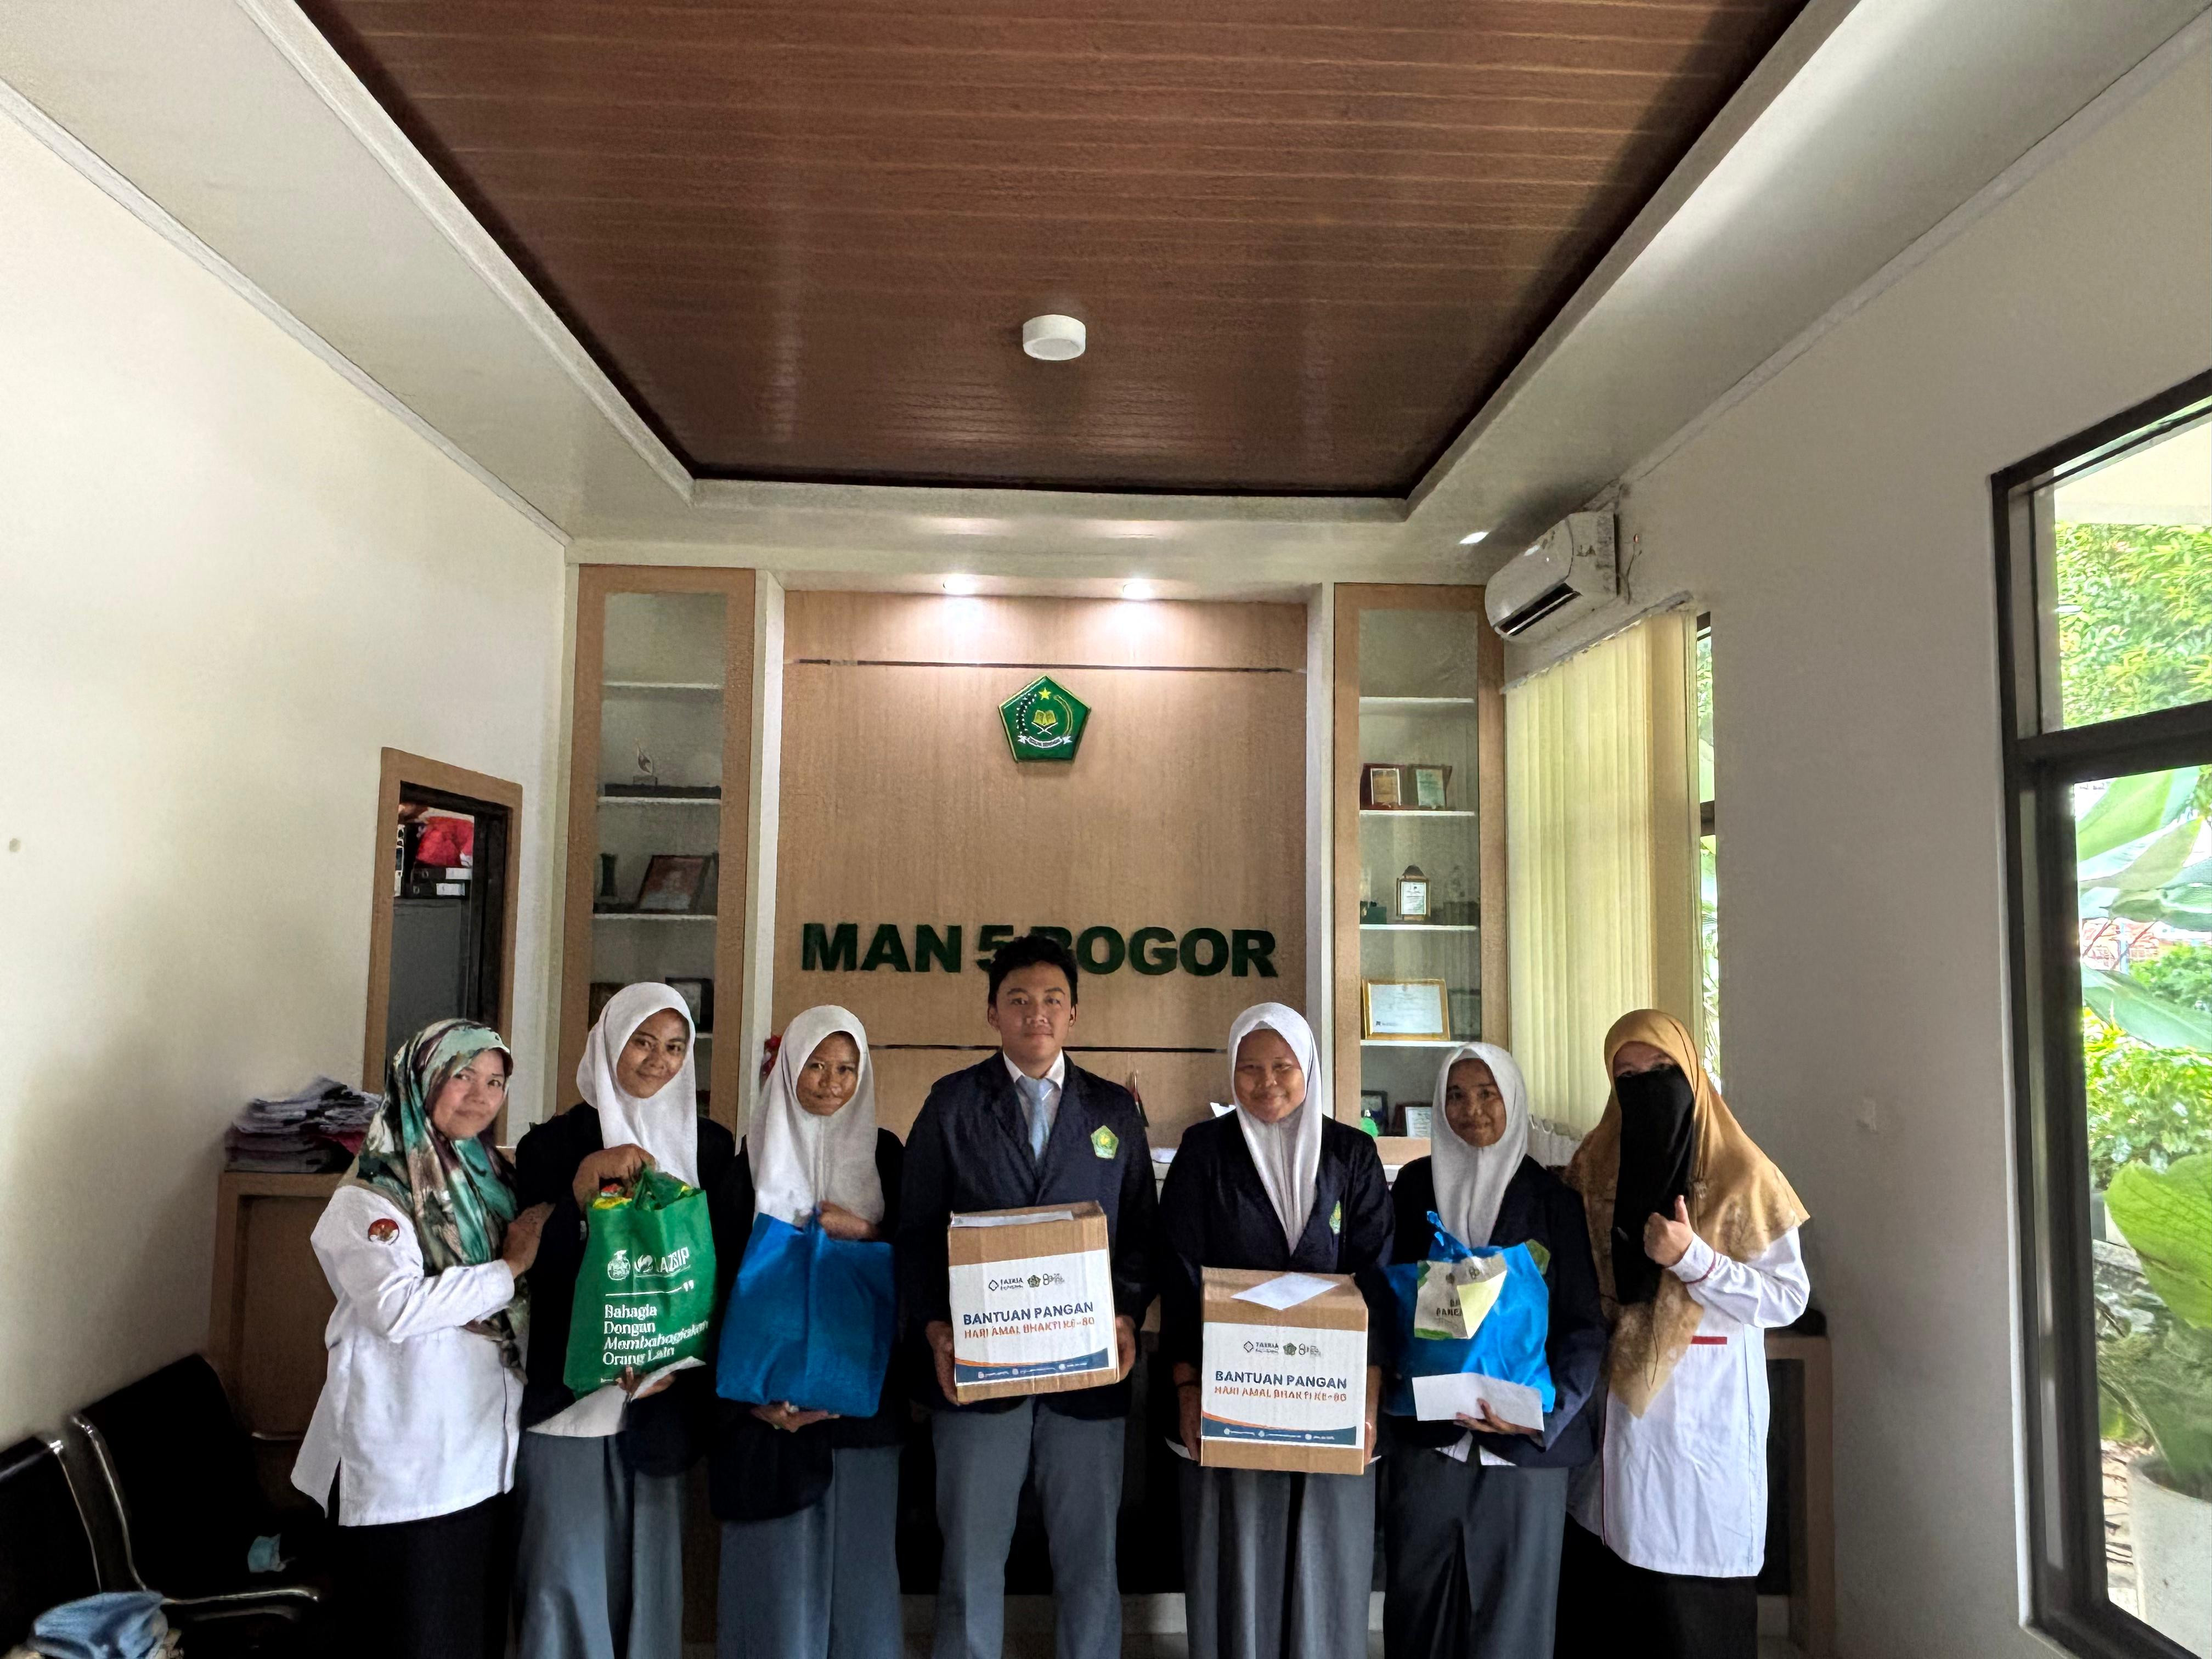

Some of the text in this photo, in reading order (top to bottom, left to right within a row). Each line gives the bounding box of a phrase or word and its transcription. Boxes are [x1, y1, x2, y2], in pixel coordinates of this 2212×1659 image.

[802, 923, 962, 973] MAN
[975, 924, 1014, 972] 5
[605, 1303, 658, 1321] Bahagia
[963, 1301, 1094, 1325] BANTUAN PANGAN
[603, 1321, 656, 1337] Dengan
[964, 1328, 989, 1339] HARI
[991, 1325, 1020, 1336] AMAL
[1023, 1321, 1061, 1334] BHAKTI
[602, 1346, 675, 1366] Orang Lain
[1215, 1370, 1347, 1389] BANTUAN PANGAN
[1214, 1385, 1239, 1395] HARI
[1242, 1387, 1271, 1398] AMAL
[1273, 1389, 1312, 1400] BHAKTI
